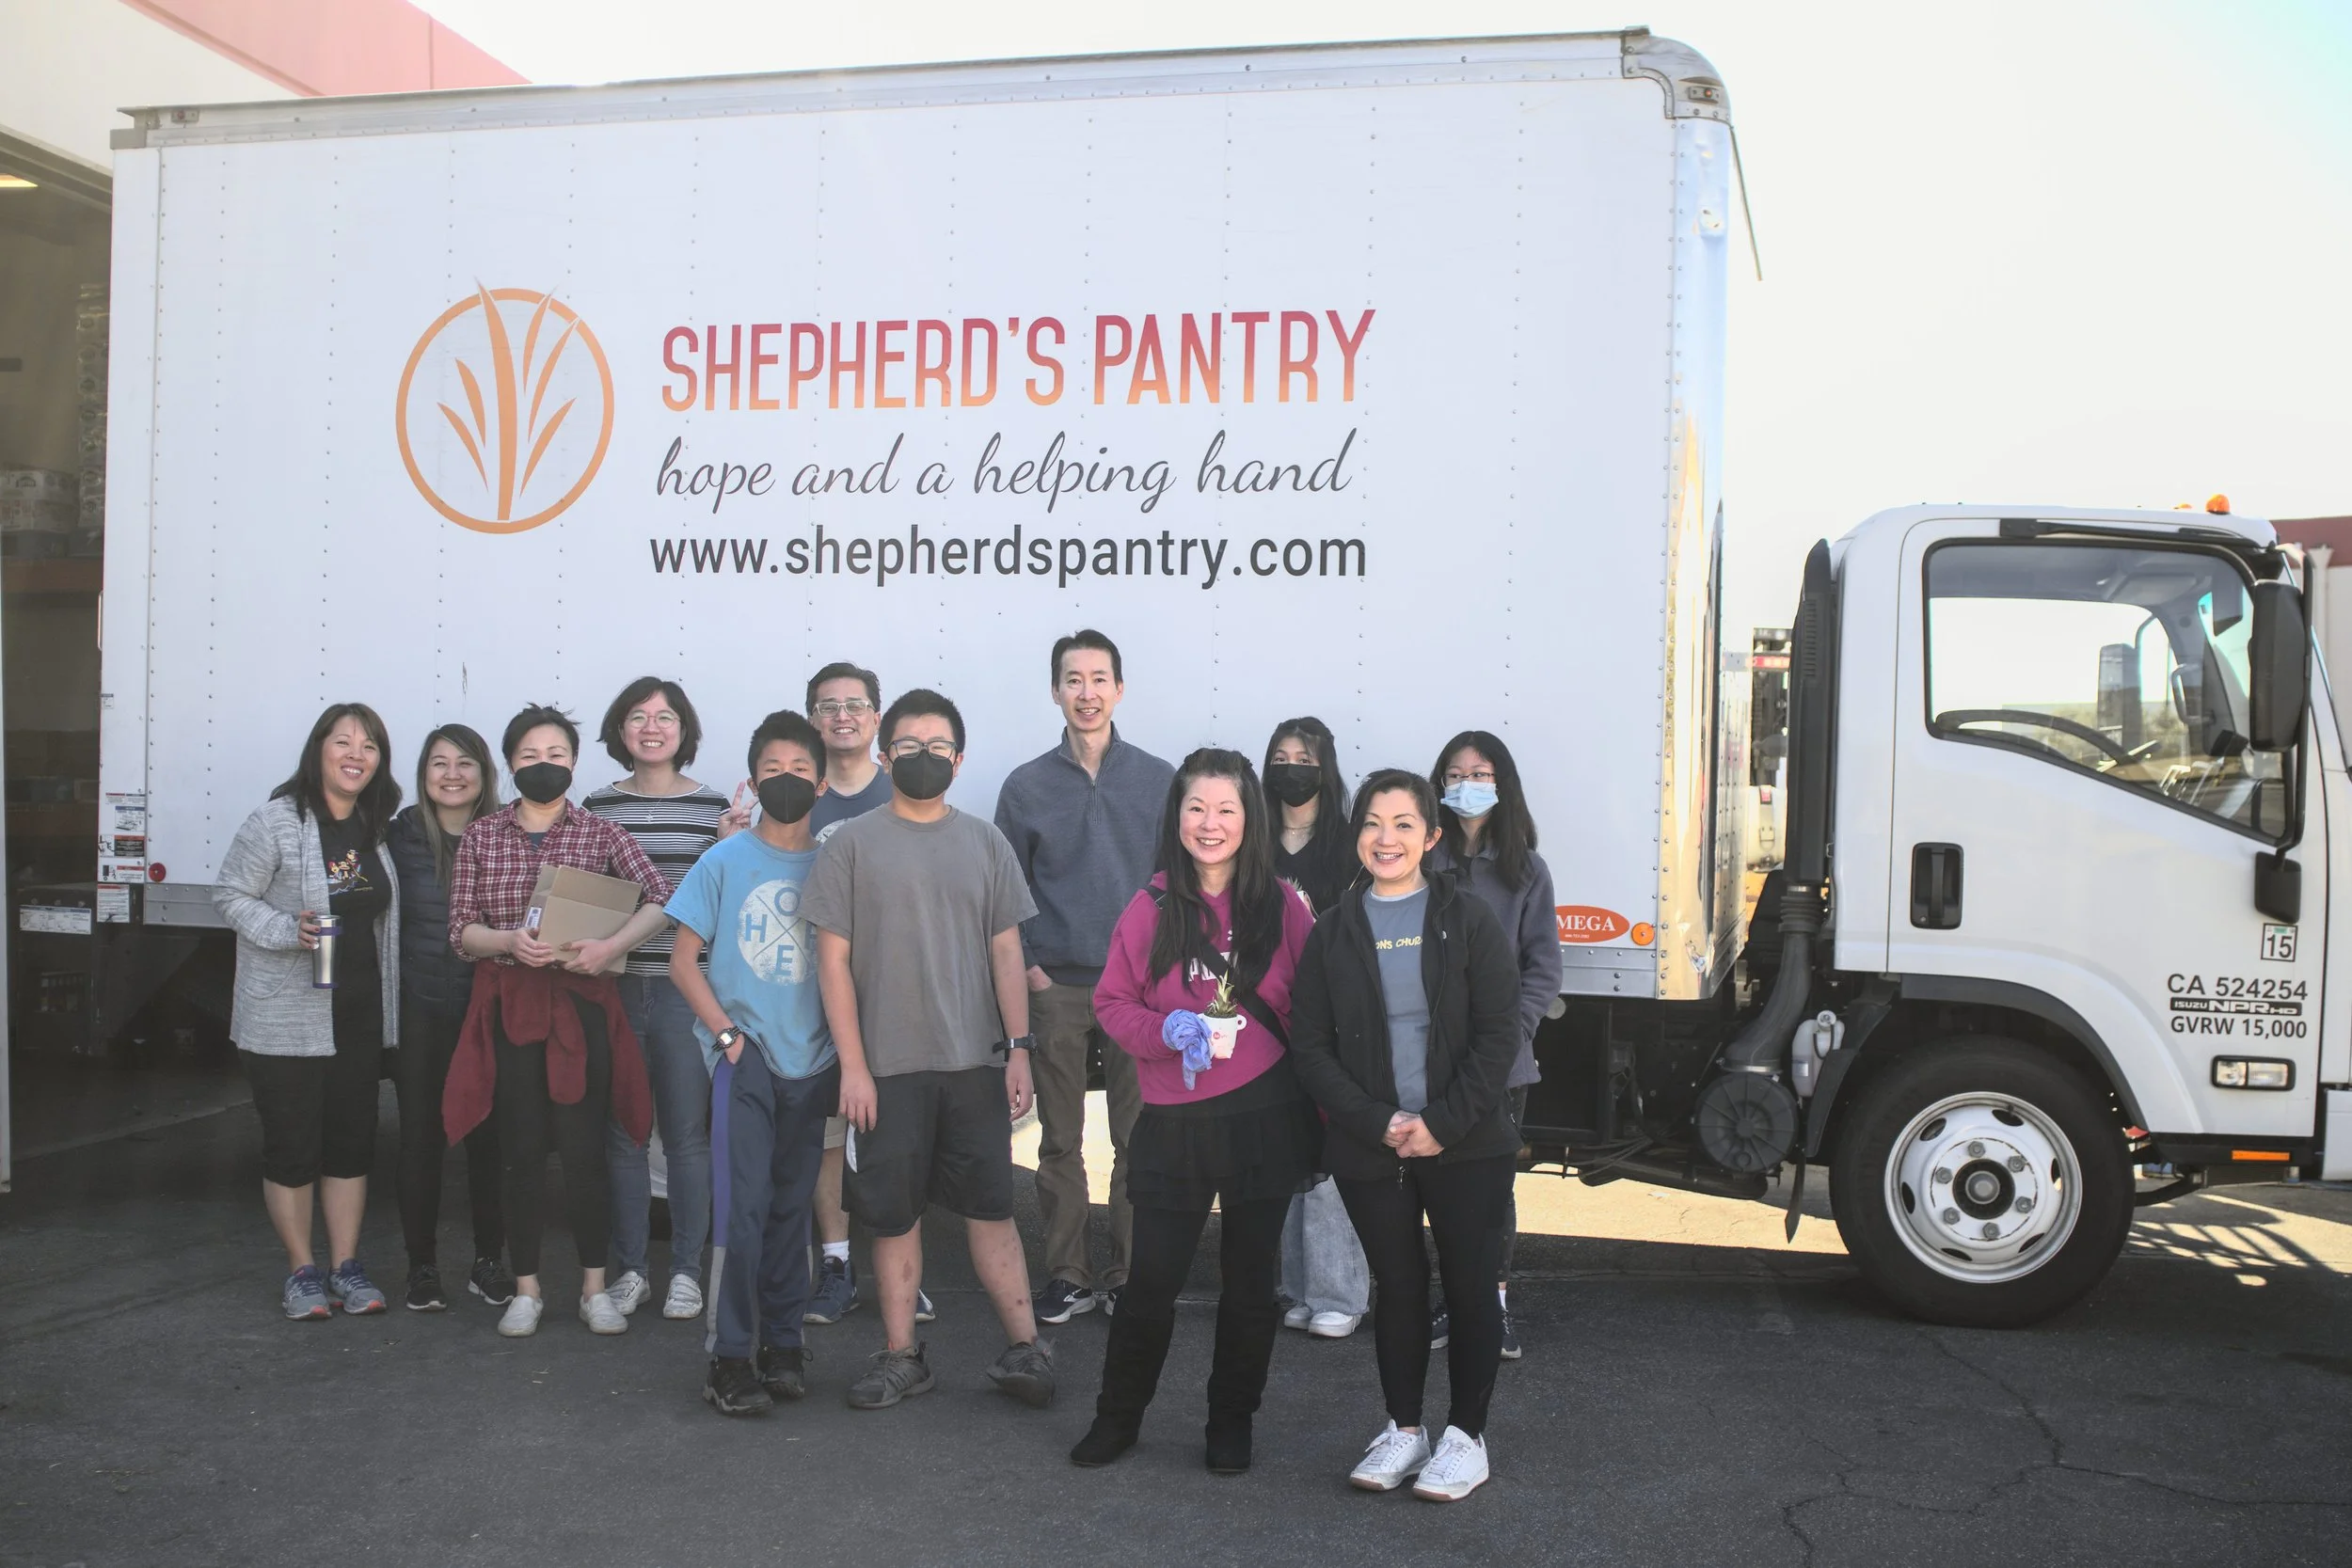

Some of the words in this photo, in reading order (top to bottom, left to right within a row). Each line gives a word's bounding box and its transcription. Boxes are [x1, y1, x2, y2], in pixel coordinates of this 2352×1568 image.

[662, 317, 1065, 411] SHEPHERD'S
[1094, 309, 1375, 404] PANTRY
[657, 436, 775, 515] hope
[791, 432, 904, 496] and
[915, 462, 955, 496] a
[974, 430, 1176, 514] helping
[1197, 427, 1358, 494] hand
[649, 524, 1366, 590] www.shepherdspantry.com
[1555, 914, 1616, 931] MEGA
[1395, 936, 1422, 948] CHUR
[2266, 934, 2294, 958] 15
[2168, 974, 2205, 995] CA
[2215, 976, 2308, 1001] 524254
[2174, 1000, 2208, 1009] ISUZU
[2170, 1016, 2234, 1035] GVRW
[2242, 1019, 2308, 1039] 15,000
